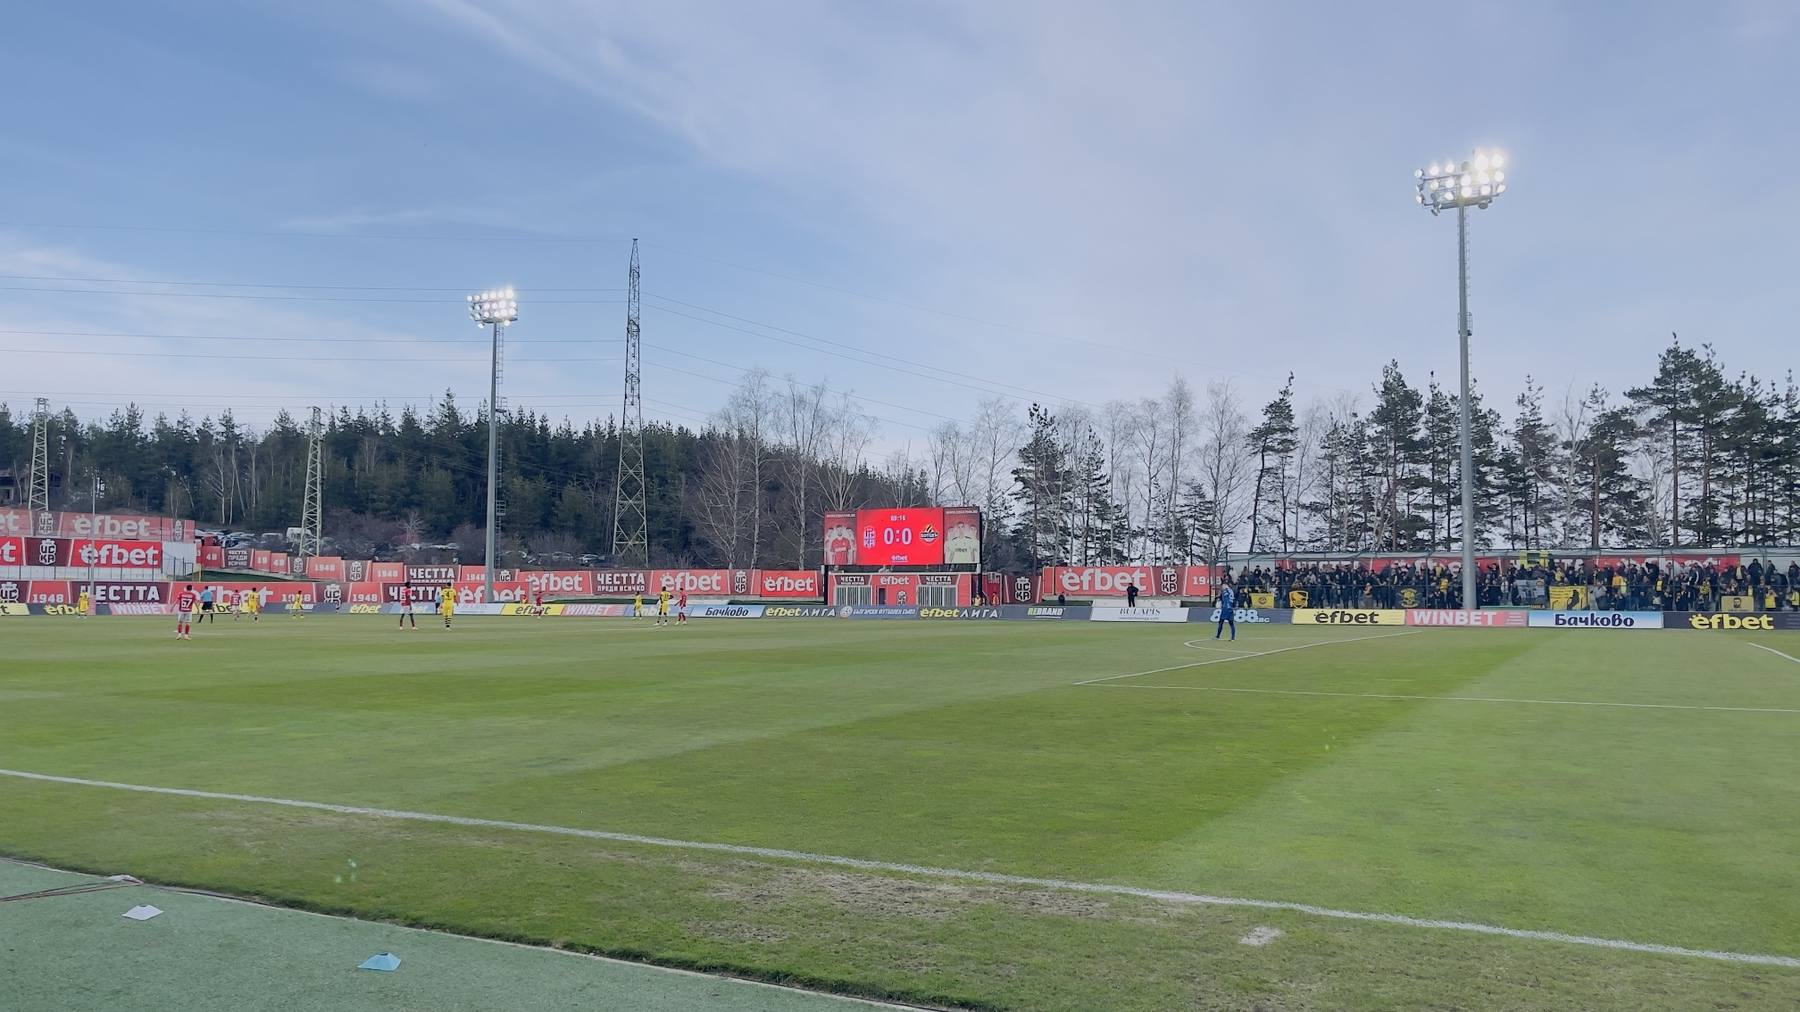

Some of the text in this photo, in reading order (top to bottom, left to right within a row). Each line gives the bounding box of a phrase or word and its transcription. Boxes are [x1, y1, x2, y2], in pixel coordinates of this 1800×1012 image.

[74, 514, 150, 536] efbet
[884, 527, 912, 544] 0:0
[81, 544, 159, 565] efbet
[409, 568, 455, 579] ЧЕСТТА
[597, 573, 645, 585] ЧЕСТТА
[528, 571, 582, 592] efbet
[660, 571, 721, 592] efbet
[764, 577, 814, 592] efbet
[880, 576, 909, 585] efbet
[1061, 569, 1147, 592] efbet
[32, 594, 64, 603] 1948
[181, 599, 192, 608] 67
[281, 594, 312, 602] 198
[352, 594, 378, 602] 1948
[565, 605, 611, 616] WINBET
[705, 607, 749, 617] Бачково
[766, 608, 836, 617] efbet ЛИГА
[920, 608, 998, 618] efbet ЛИГА
[1315, 611, 1379, 624] efbet
[1413, 611, 1497, 625] WINBET
[1555, 613, 1635, 627] Бачково
[1690, 614, 1774, 630] efbet
